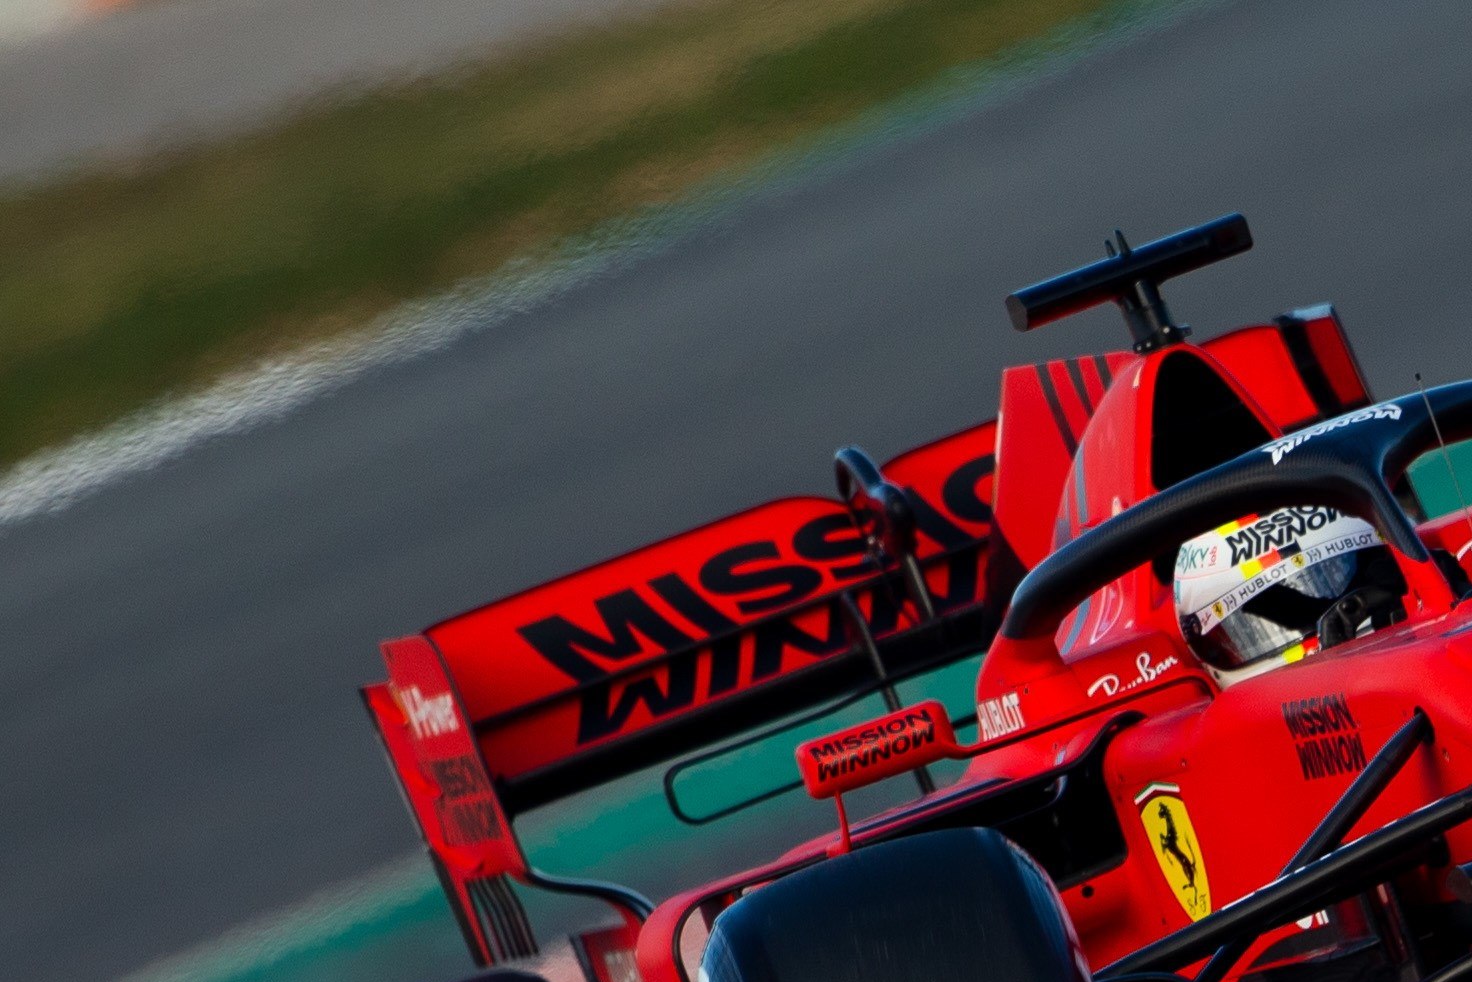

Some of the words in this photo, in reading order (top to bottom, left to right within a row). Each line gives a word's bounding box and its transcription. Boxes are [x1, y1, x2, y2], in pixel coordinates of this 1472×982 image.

[1326, 533, 1375, 556] HUBLOT
[1237, 564, 1289, 602] HUBLOT
[809, 708, 933, 762] MISSION
[1282, 692, 1358, 740] MISSION
[817, 725, 935, 783] WINNOW
[1296, 732, 1367, 781] WINNOW
